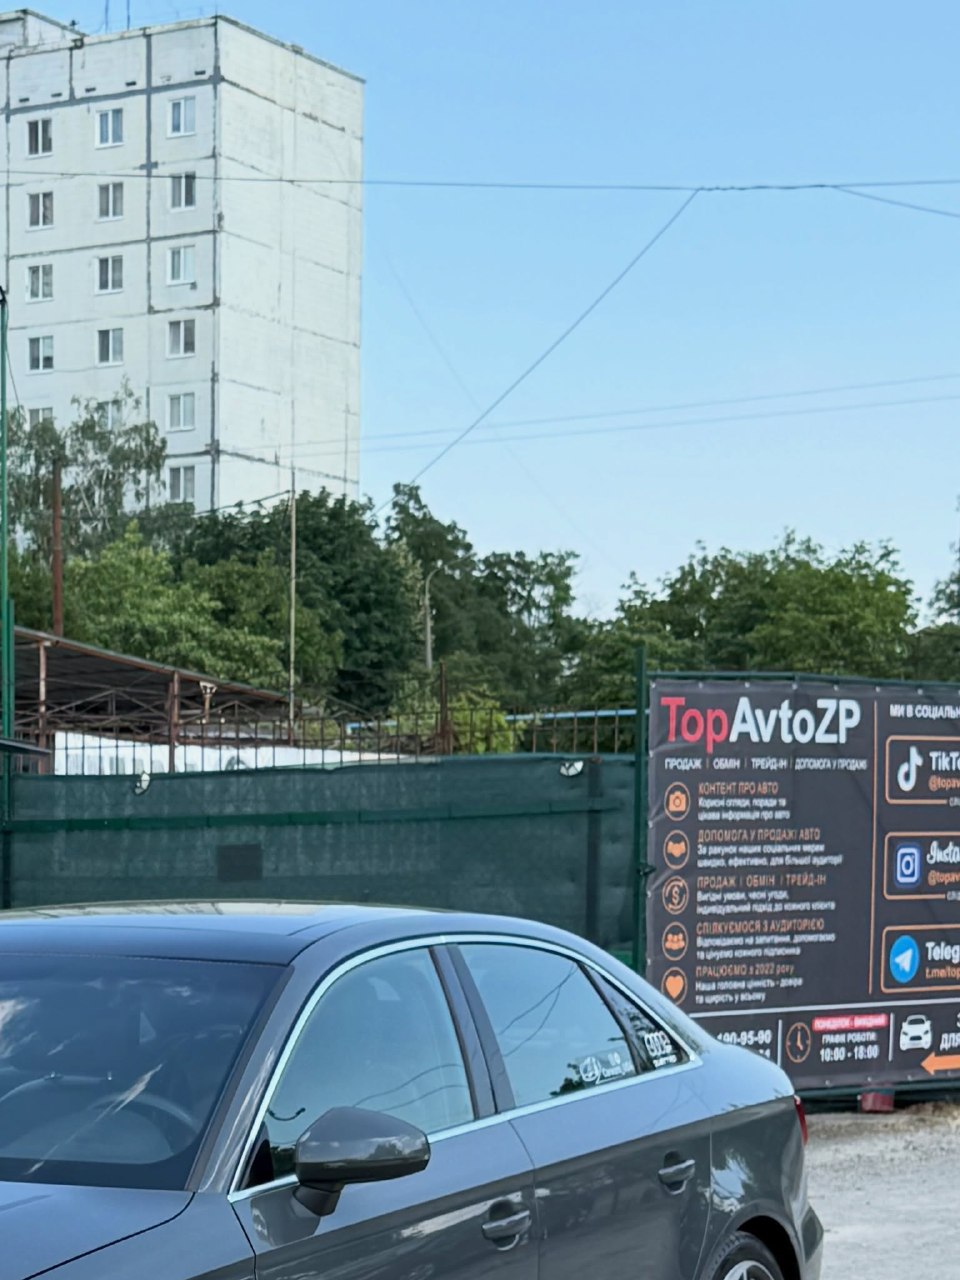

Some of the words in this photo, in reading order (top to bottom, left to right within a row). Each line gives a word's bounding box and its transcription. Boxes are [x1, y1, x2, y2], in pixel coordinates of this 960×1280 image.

[660, 696, 861, 754] TopAvtoZP
[664, 757, 702, 771] ПРОДАЖ
[713, 758, 740, 770] ОБМІН
[698, 782, 738, 796] КОНТЕНТ
[739, 782, 755, 795] ПРО
[757, 782, 778, 794] АВТО
[698, 829, 748, 843] ДОПОМОГА
[799, 828, 821, 841] АВТО
[697, 875, 736, 889] ПРОДАЖ
[746, 873, 775, 887] ОБМІН
[696, 921, 761, 935] СПІЛКУЄМОСЯ
[769, 918, 825, 933] АУДИТОРІЄЮ
[696, 964, 746, 978] ПРАЦЮЄМО
[754, 962, 775, 975] 2022
